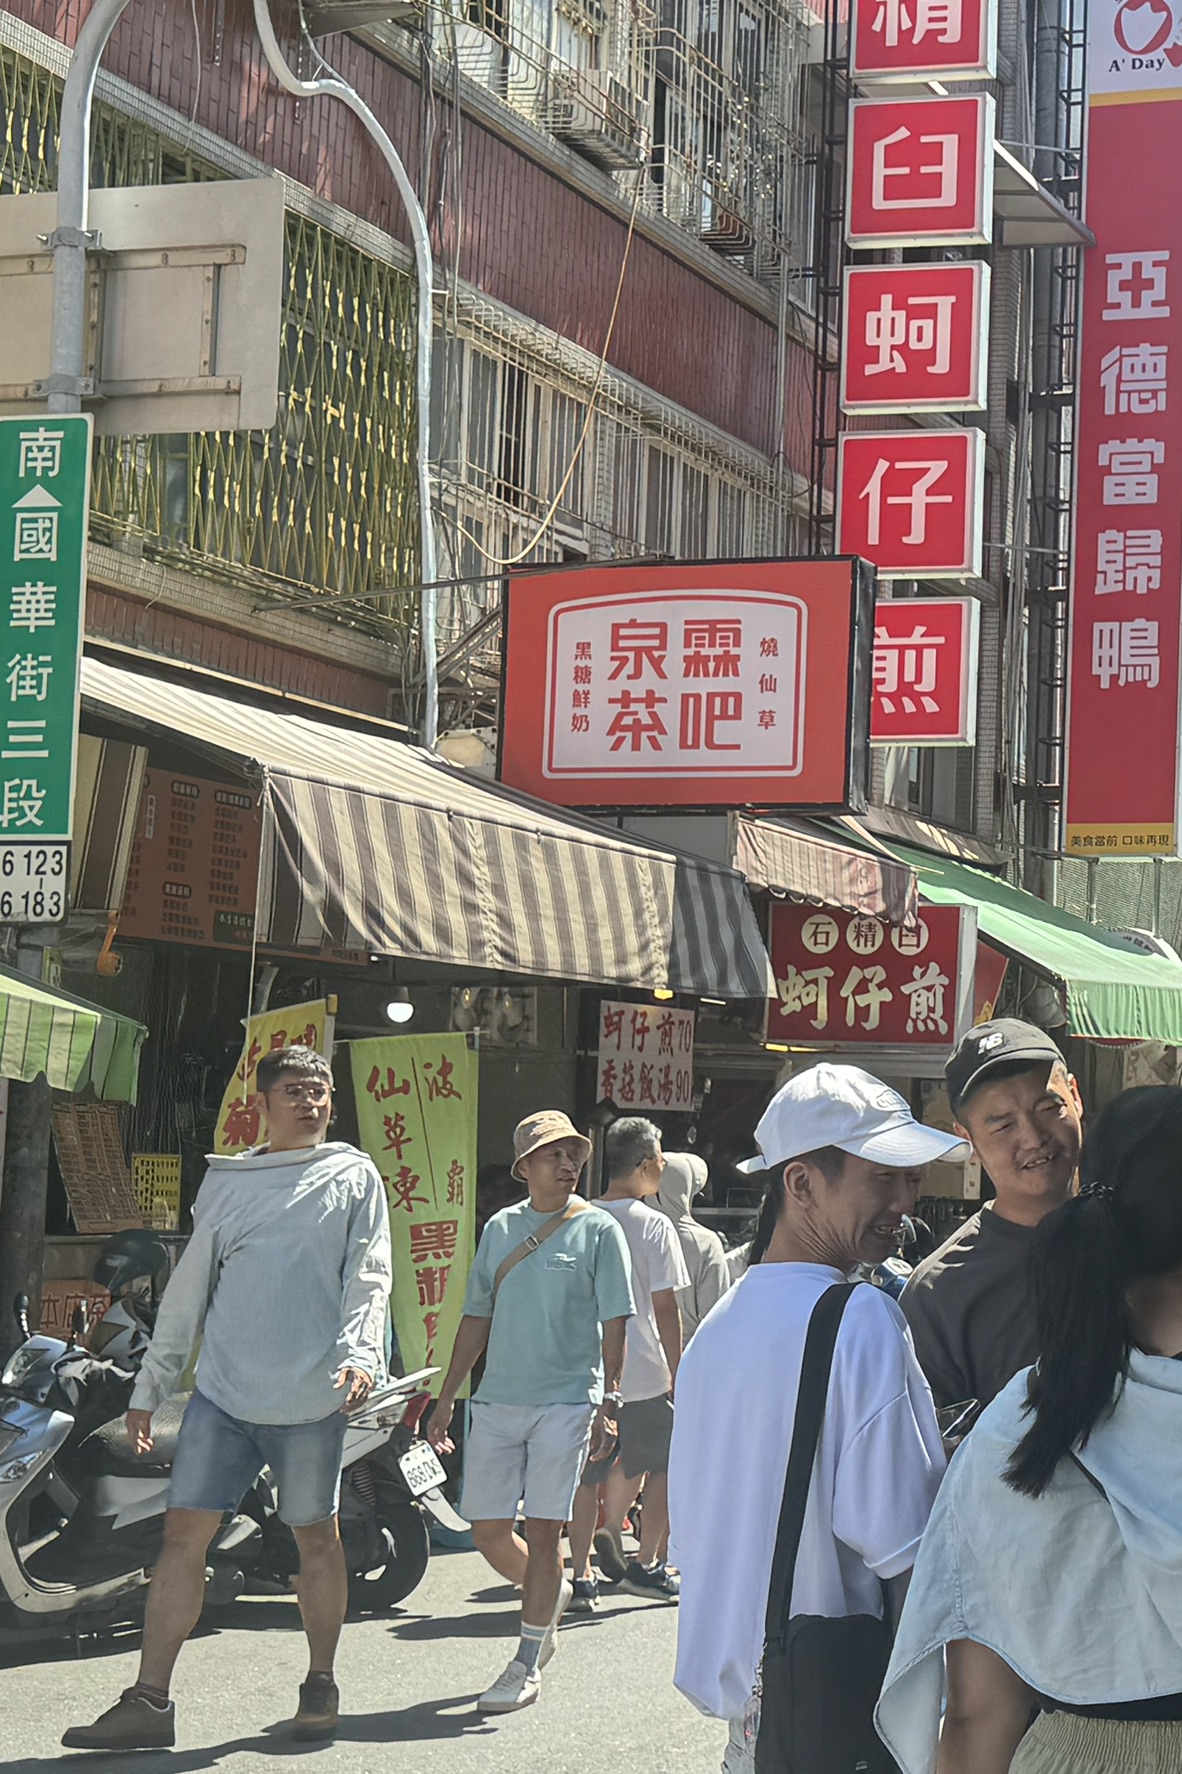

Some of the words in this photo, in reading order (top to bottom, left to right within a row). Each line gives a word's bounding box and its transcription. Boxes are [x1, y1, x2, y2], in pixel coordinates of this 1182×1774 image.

[1131, 57, 1166, 72] Day
[18, 427, 65, 479] 南
[1091, 250, 1170, 689] 亞德當歸鴨
[0, 511, 59, 828] 國華街三段
[570, 640, 593, 733] 黑糖鮮奶
[757, 636, 779, 731] 燒仙草
[605, 688, 743, 752] 茶吧
[2, 849, 15, 877] 6
[23, 849, 64, 877] 123
[1071, 834, 1118, 848] 美食當前
[1122, 833, 1170, 847] 口味再現
[0, 890, 13, 918] 6
[21, 890, 61, 918] 183
[777, 961, 951, 1036] 蚵仔煎
